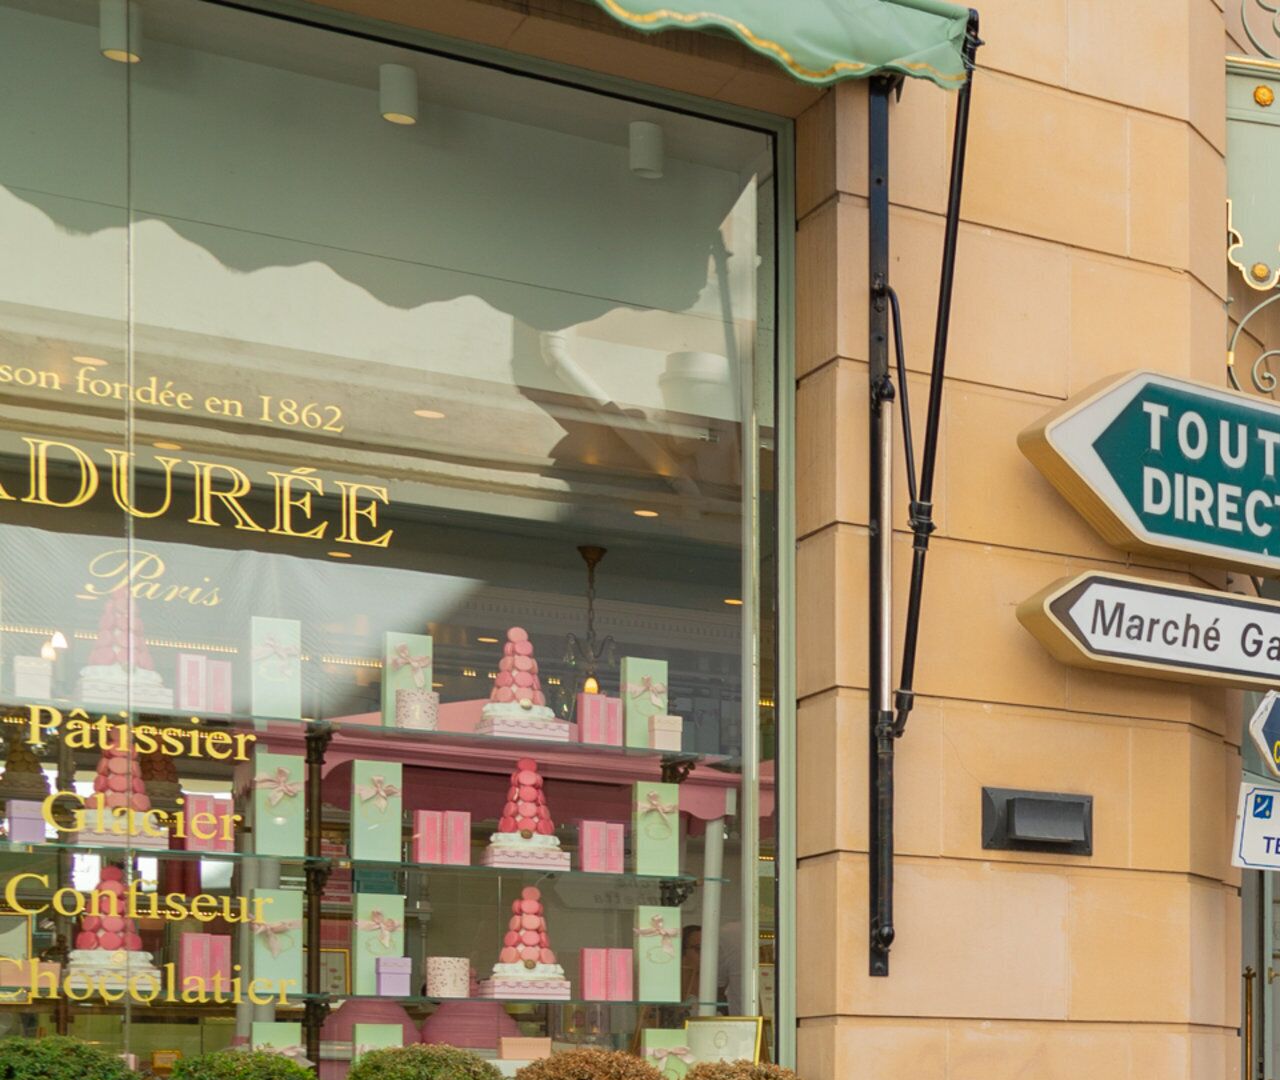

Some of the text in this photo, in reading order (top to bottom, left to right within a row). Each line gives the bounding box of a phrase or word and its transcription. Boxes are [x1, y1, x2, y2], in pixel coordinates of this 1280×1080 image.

[76, 366, 194, 410] fondée
[205, 396, 244, 418] en
[260, 395, 344, 432] 1862
[0, 437, 394, 548] DURÉE
[85, 549, 222, 607] Paris
[1091, 599, 1221, 652] Marché
[25, 704, 257, 761] Pâtissier
[41, 790, 243, 841] Glacier
[4, 872, 274, 924] Confiseur
